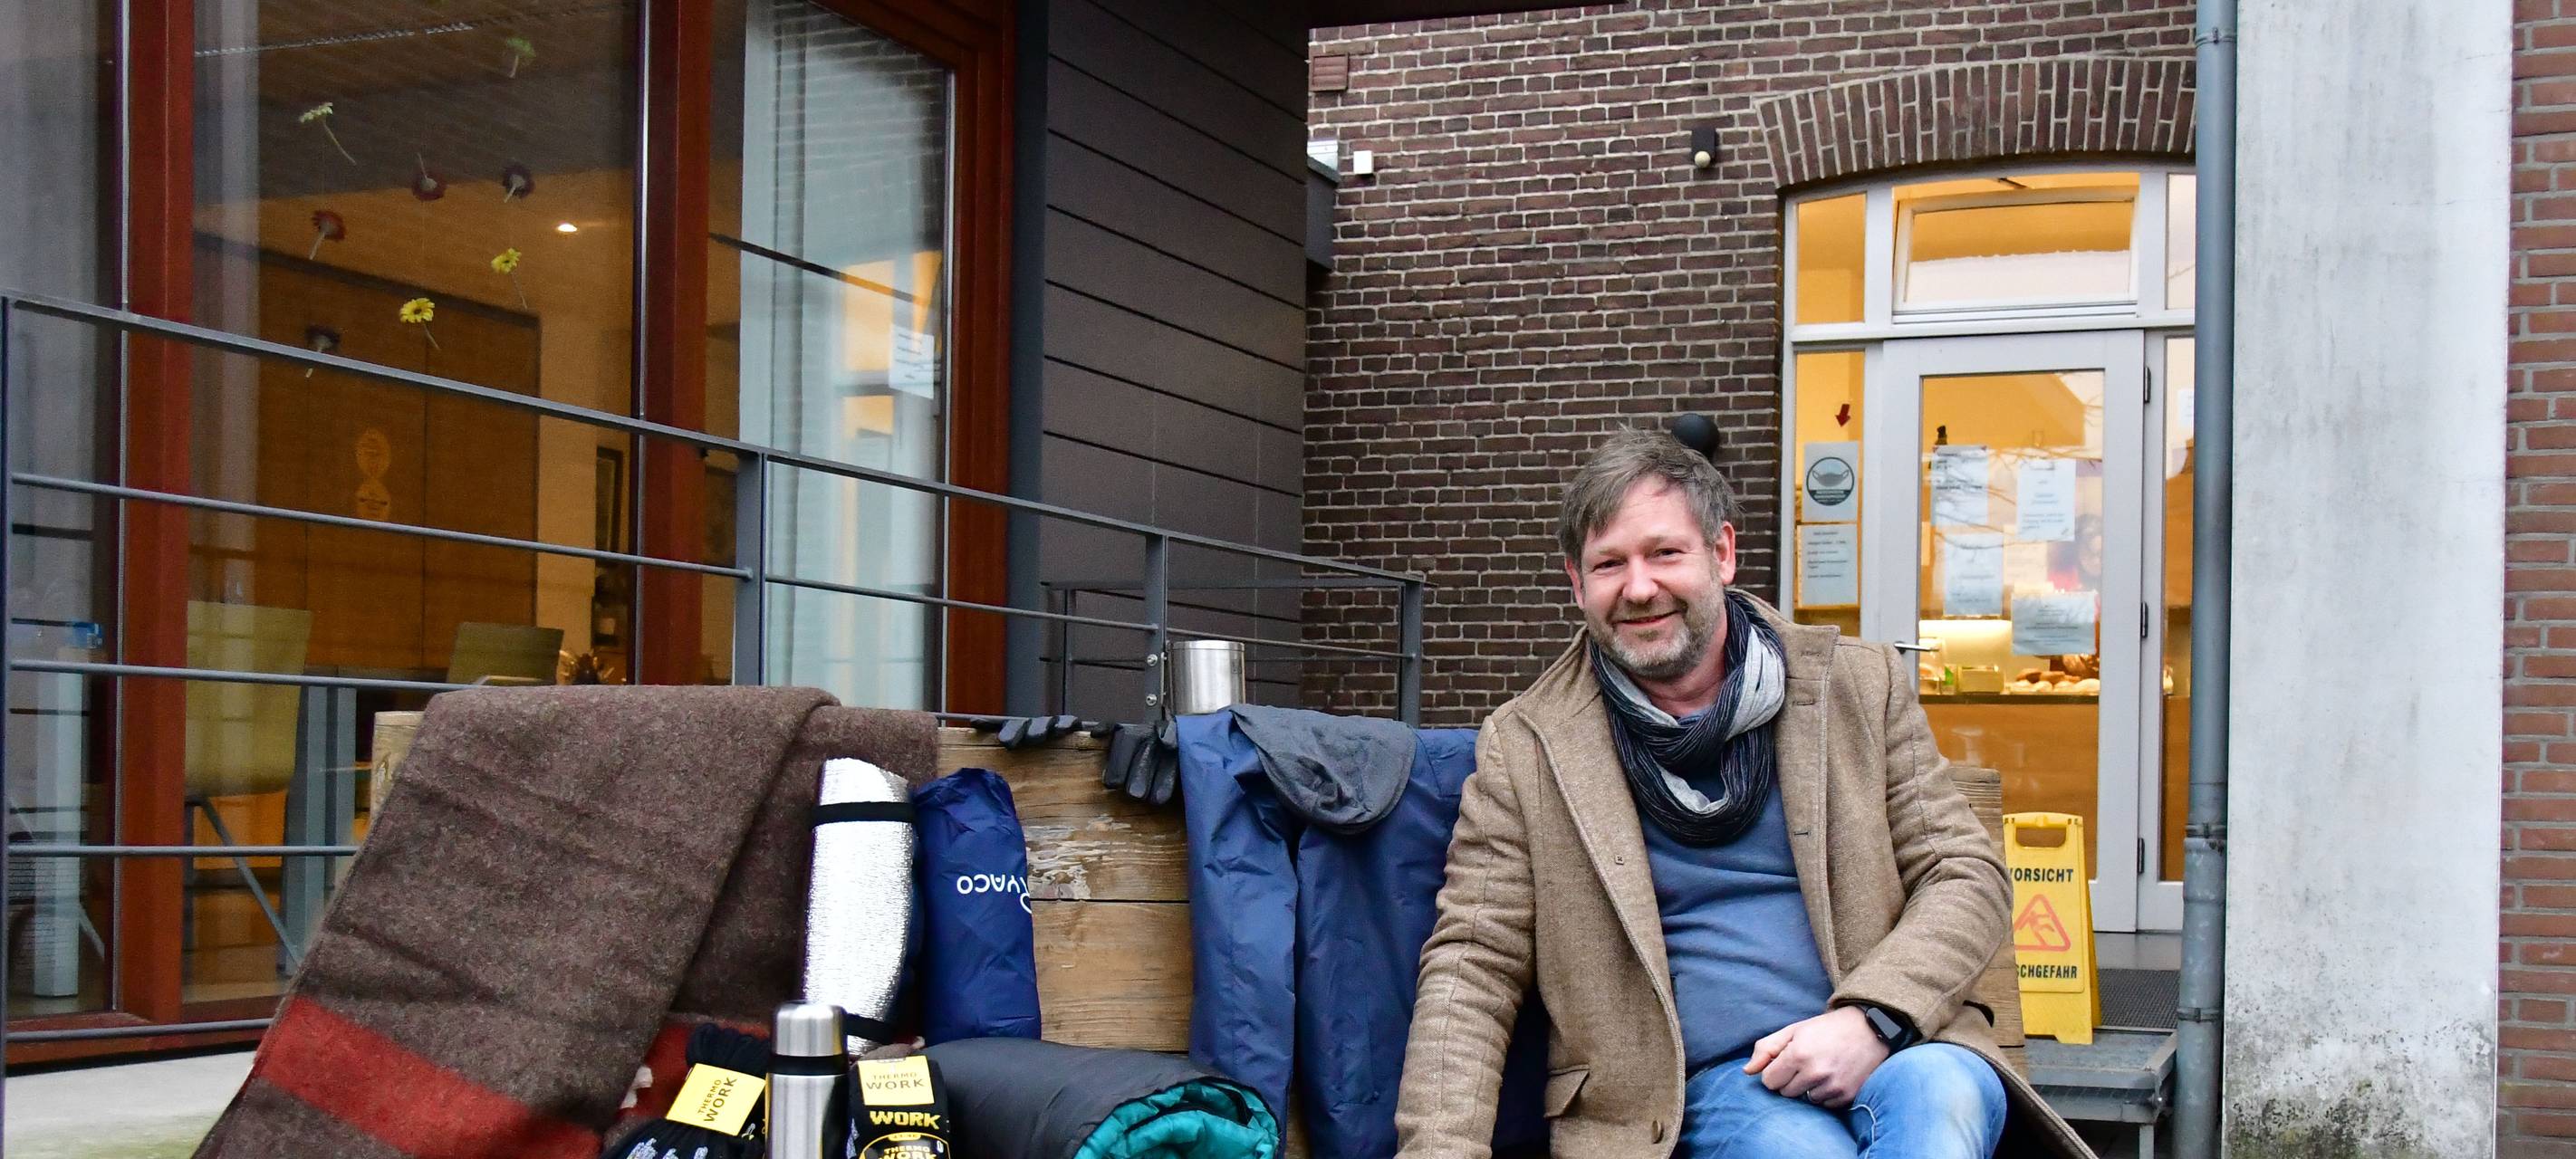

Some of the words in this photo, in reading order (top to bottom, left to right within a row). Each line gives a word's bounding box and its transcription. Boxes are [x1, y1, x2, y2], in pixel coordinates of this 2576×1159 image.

[2010, 867, 2073, 882] ORSICHT
[866, 1079, 924, 1089] WORK
[697, 1079, 721, 1115] THERMO
[704, 1078, 737, 1122] WORK
[870, 1110, 941, 1130] WORK
[884, 1145, 930, 1154] THERMO
